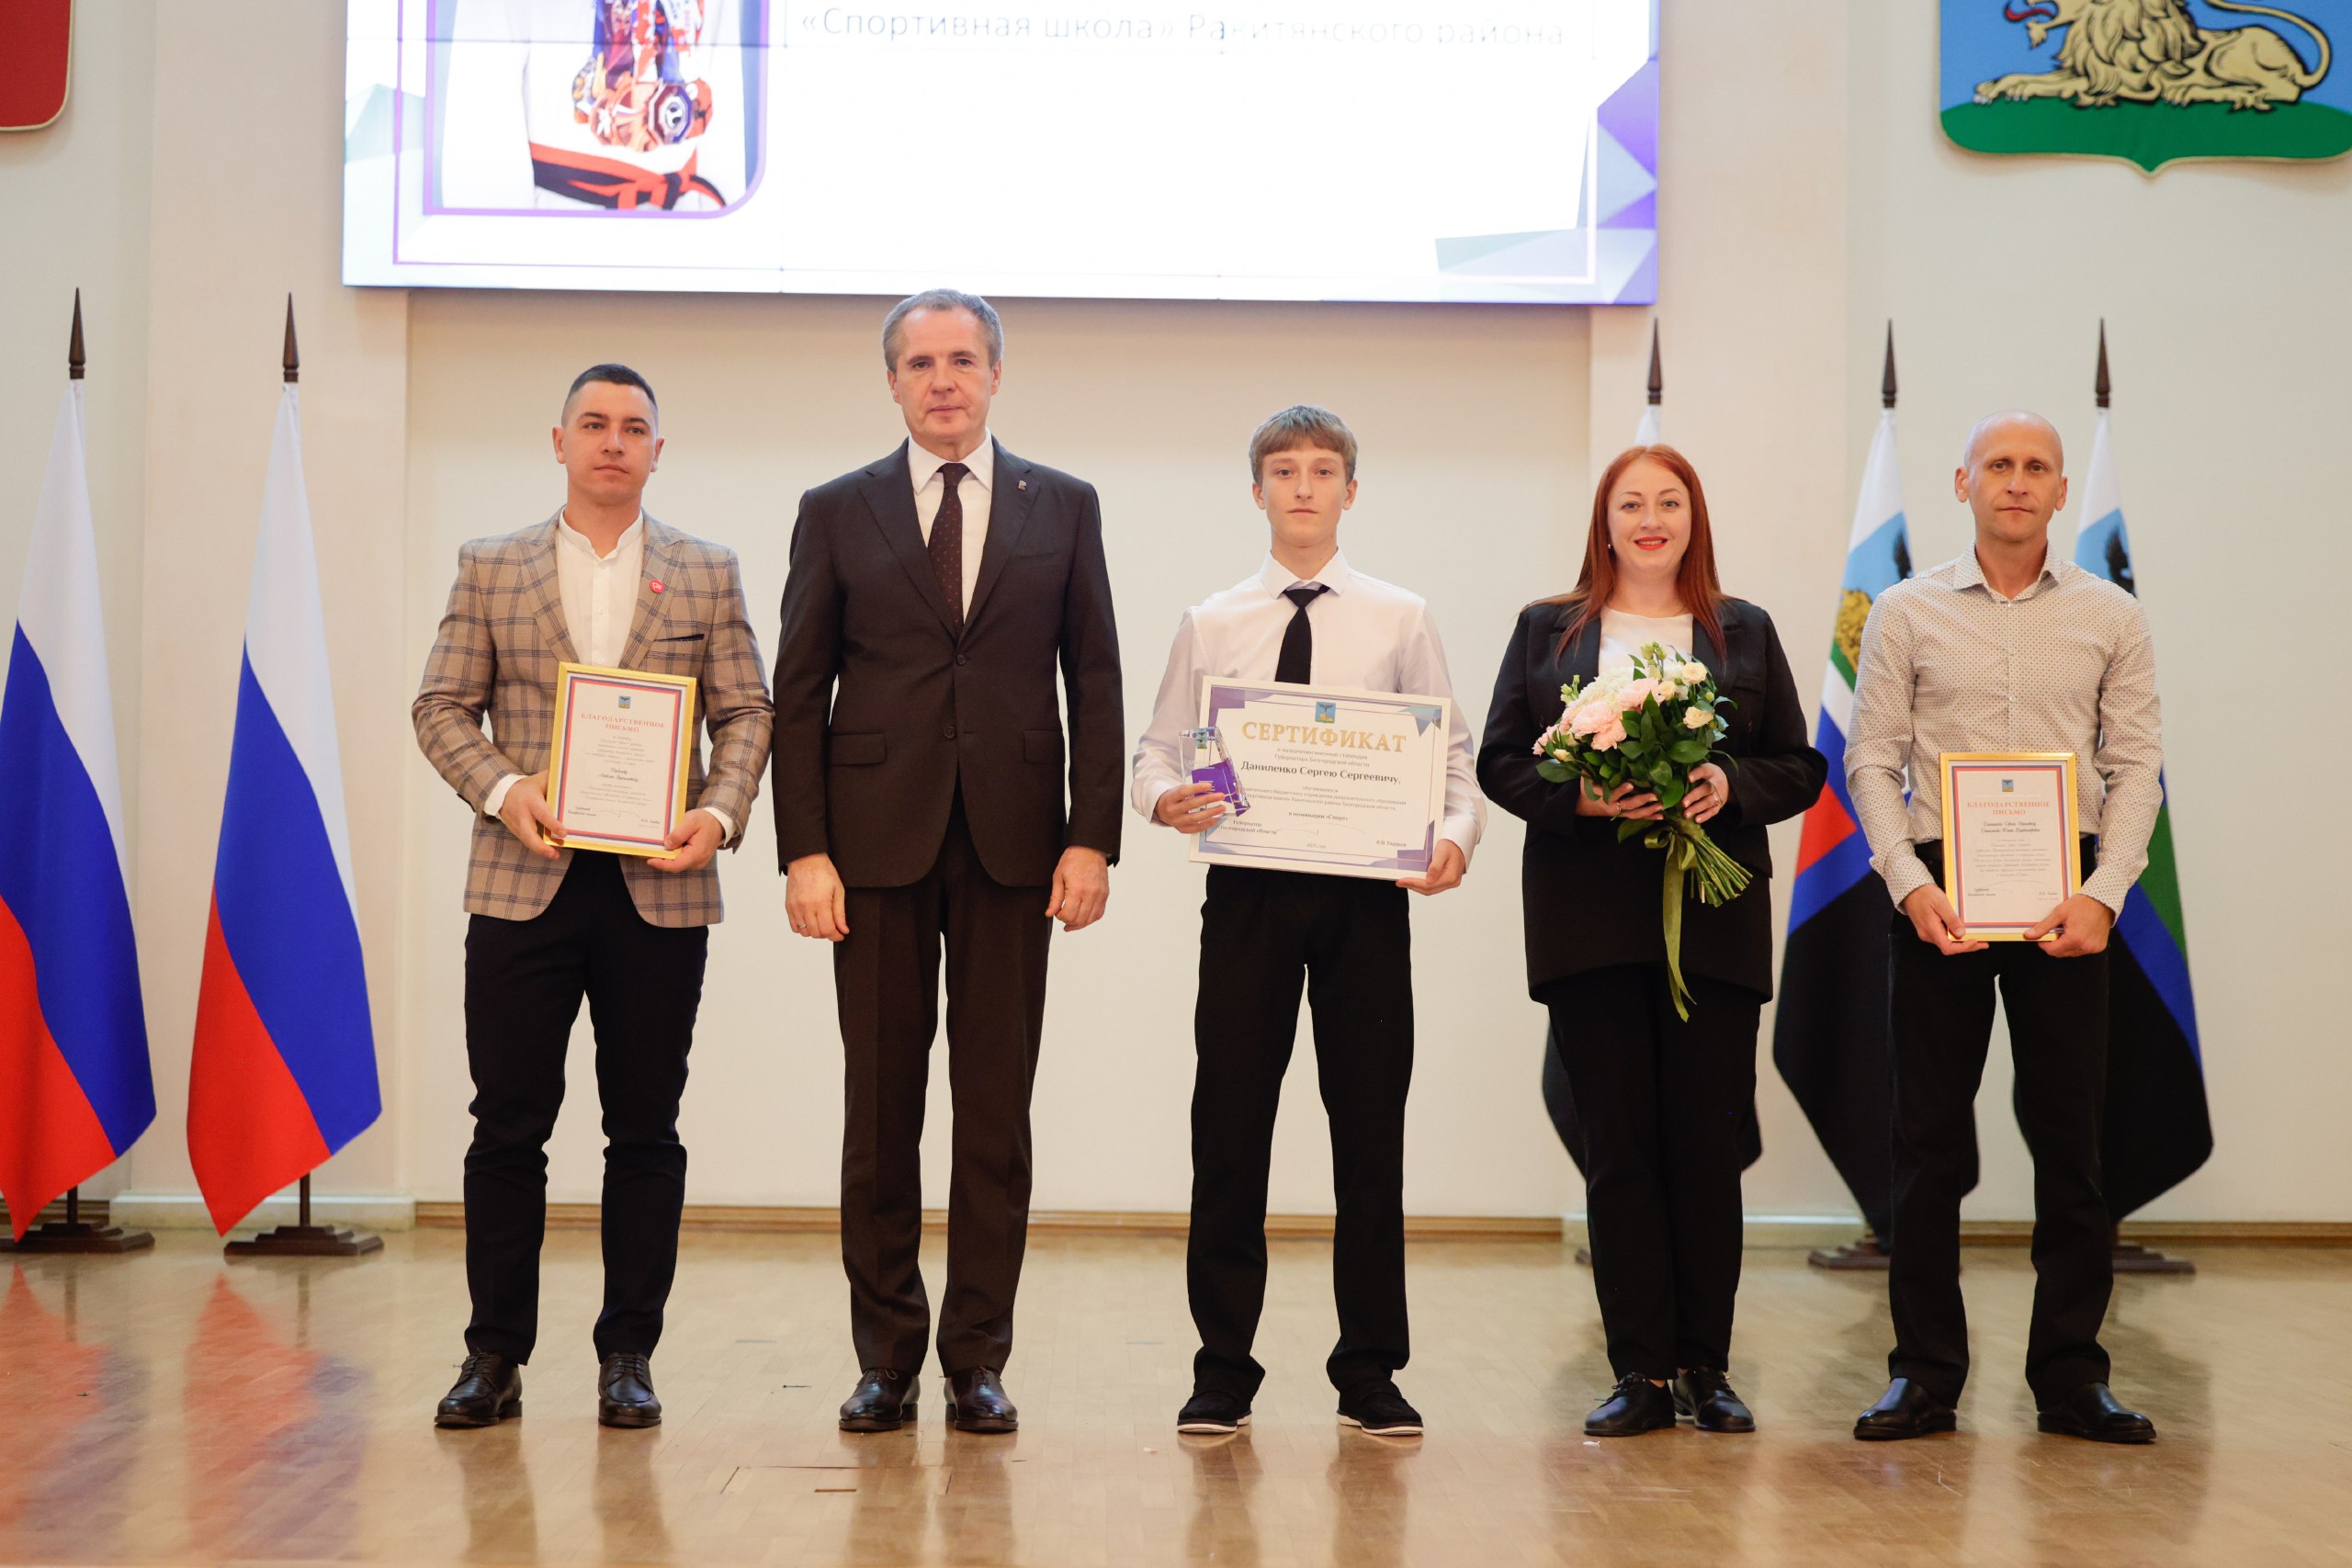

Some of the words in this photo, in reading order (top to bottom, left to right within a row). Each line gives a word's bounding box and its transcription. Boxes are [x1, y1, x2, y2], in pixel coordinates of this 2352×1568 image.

[802, 6, 1031, 41] «Спортивная
[1045, 14, 1174, 39] школа»
[1189, 13, 1424, 44] Ракитянского
[1437, 13, 1563, 50] района
[582, 713, 665, 728] БЛАГОДАРСТВЕННОЕ
[605, 724, 639, 732] ПИСЬМО
[1242, 721, 1407, 752] СЕРТИФИКАТ
[1240, 761, 1297, 774] Даниленко
[1299, 766, 1337, 778] Сергею
[1340, 770, 1401, 784] Сергеевичу,
